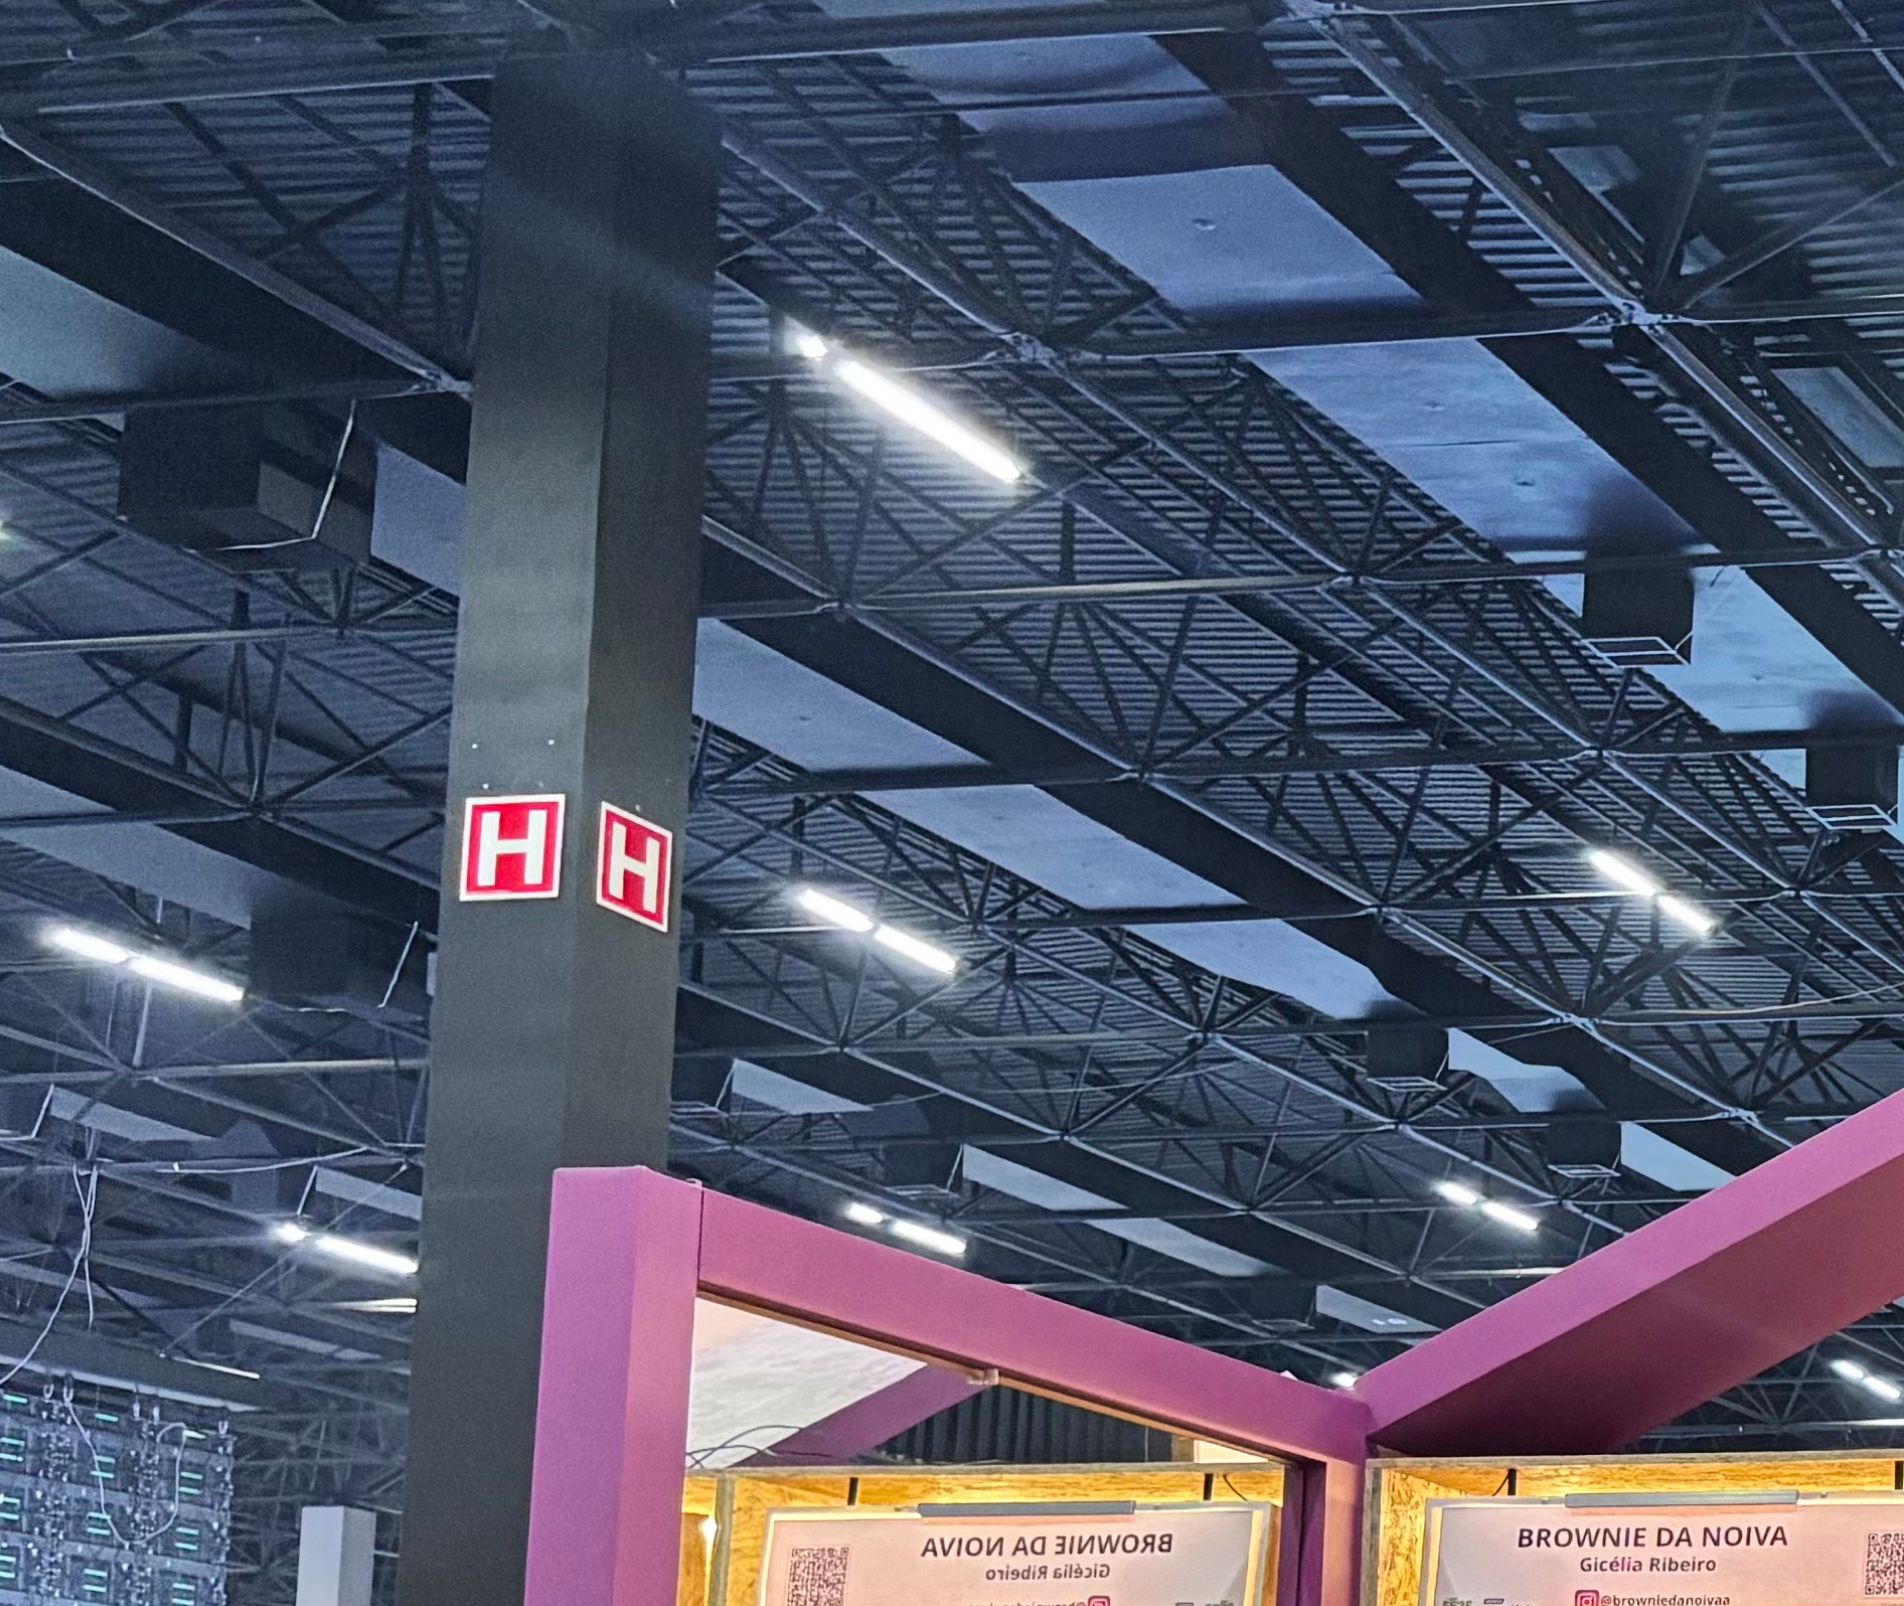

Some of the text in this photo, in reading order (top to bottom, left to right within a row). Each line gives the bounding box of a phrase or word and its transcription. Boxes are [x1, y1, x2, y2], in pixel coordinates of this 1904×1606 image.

[478, 810, 547, 886] H
[609, 821, 660, 913] H
[1517, 1525, 1788, 1549] BROWNIE DA NOIVA
[1579, 1556, 1717, 1573] Gicélia Ribeiro
